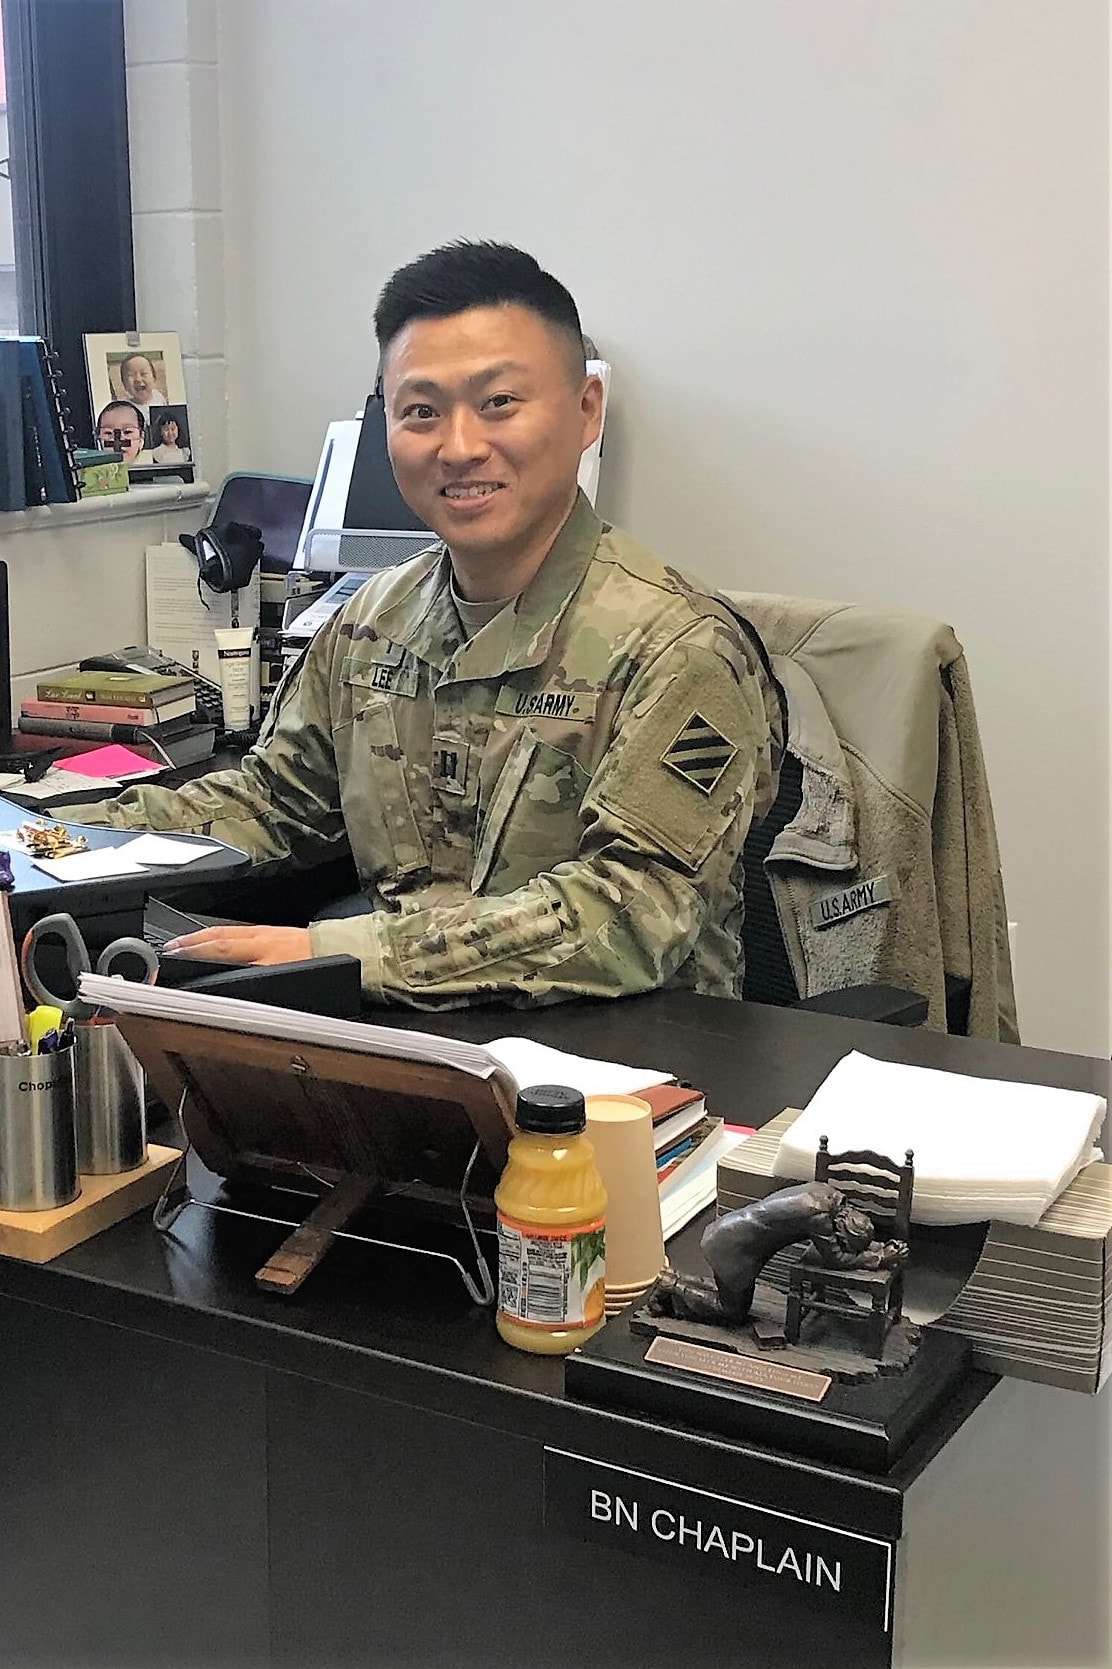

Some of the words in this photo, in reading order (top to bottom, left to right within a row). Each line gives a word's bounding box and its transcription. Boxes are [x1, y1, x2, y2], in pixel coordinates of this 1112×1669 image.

[372, 666, 394, 689] LEE
[590, 1488, 639, 1532] BN
[651, 1509, 842, 1592] CHAPLAIN
